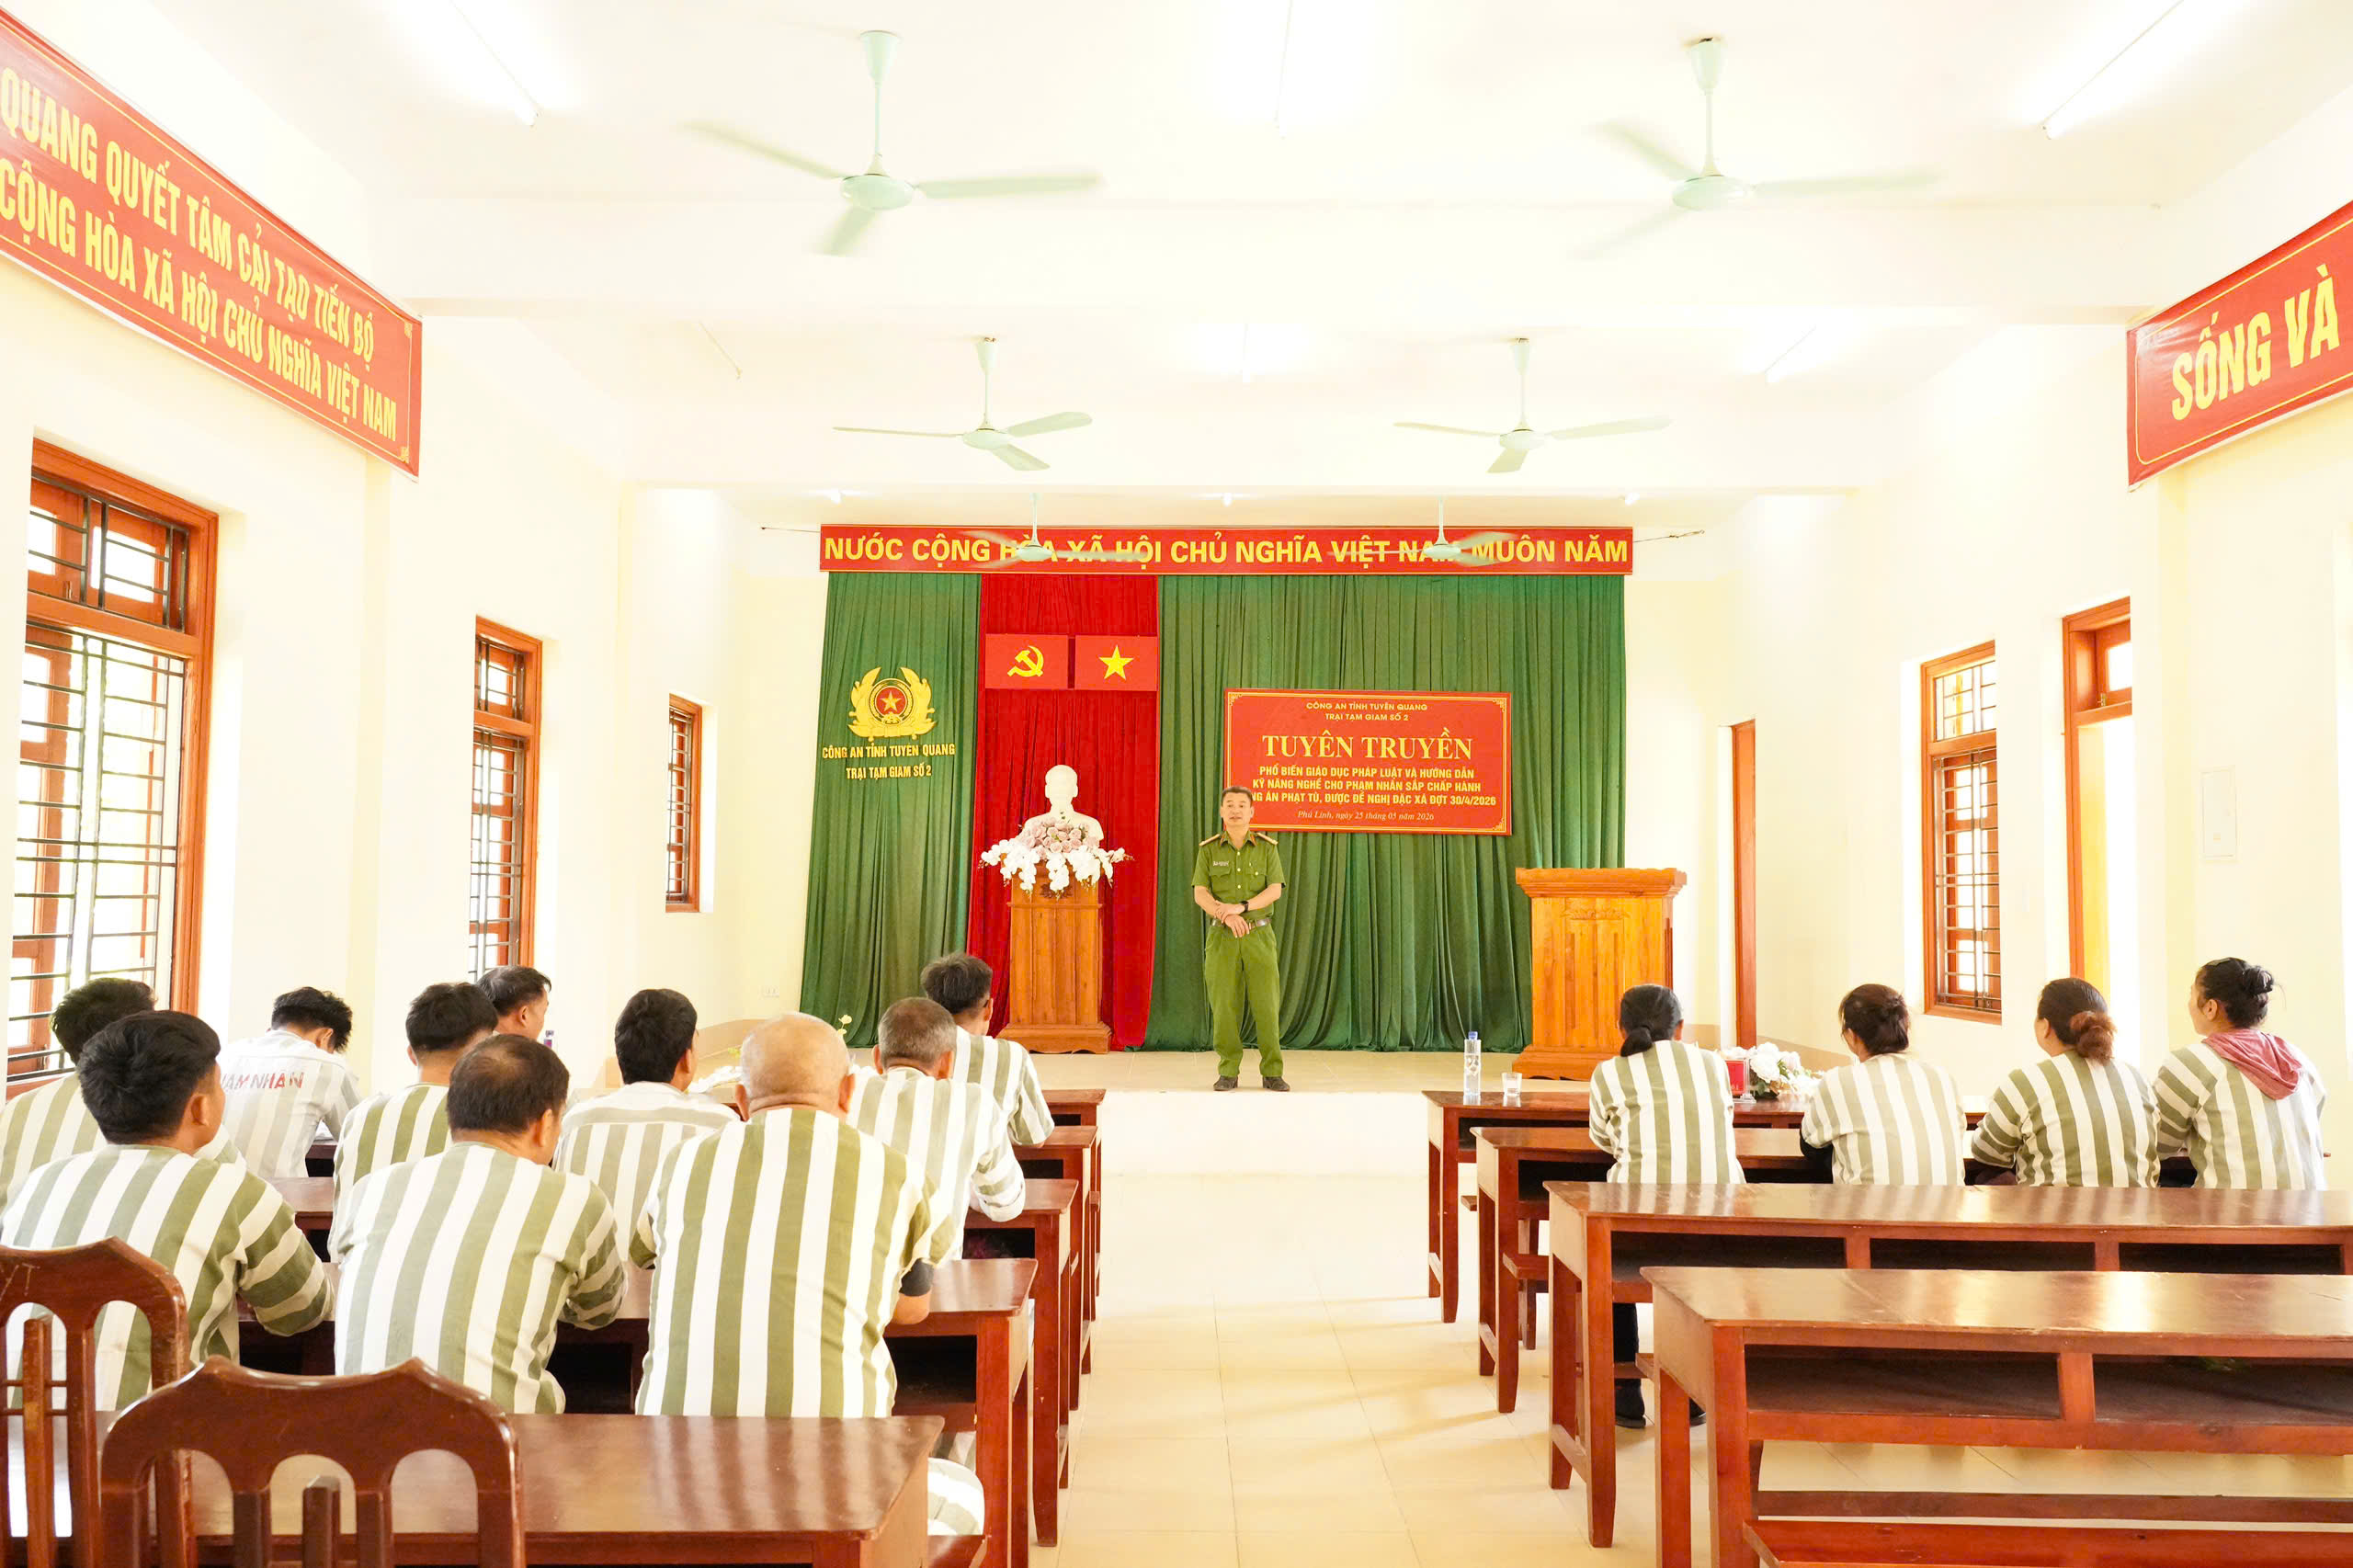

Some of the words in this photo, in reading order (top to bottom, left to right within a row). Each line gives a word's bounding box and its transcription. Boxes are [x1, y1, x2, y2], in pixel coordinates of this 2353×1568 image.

[1, 67, 97, 184] QUANG
[106, 140, 181, 236] QUYẾT
[187, 194, 232, 272] TÂM
[237, 222, 272, 296] CẢI
[274, 256, 310, 323] TẠO
[313, 283, 350, 347] TIẾN
[353, 312, 374, 372] BỘ
[0, 157, 76, 258] CỘNG
[85, 210, 137, 293] HÒA
[143, 246, 175, 314] XÃ
[181, 270, 219, 344] HỘI
[223, 295, 264, 363] CHỦ
[267, 324, 322, 399] NGHĨA
[326, 360, 360, 424] VIỆT
[362, 383, 397, 442] NAM
[2171, 310, 2272, 422] SỐNG
[2284, 263, 2340, 369] VÀ
[824, 531, 904, 561] NƯỚC
[913, 533, 991, 568] CỘNG
[1116, 534, 1162, 570] HỘI
[1171, 531, 1228, 563] CHỦ
[1235, 534, 1323, 562] NGHĨA
[1330, 534, 1391, 569] VIỆT
[1564, 533, 1628, 562] NĂM
[1306, 700, 1332, 710] CÔNG
[1348, 701, 1368, 710] TỈNH
[1370, 701, 1394, 710] TUYÊN
[1325, 712, 1343, 722] TRẠI
[1345, 713, 1362, 722] TẠM
[1389, 711, 1402, 721] SỐ
[823, 744, 847, 759] CÔNG
[849, 746, 863, 758] AN
[890, 743, 919, 757] TUYÊN
[922, 743, 956, 756] QUANG
[1262, 729, 1353, 758] TUYÊN
[1361, 727, 1472, 760] TRUYỀN
[846, 767, 867, 780] TRẠI
[869, 767, 887, 780] TẠM
[889, 765, 911, 778] GIAM
[913, 762, 925, 777] SỐ
[926, 764, 932, 776] 2
[1306, 766, 1328, 777] GIÁO
[1330, 767, 1349, 778] DỤC
[1352, 766, 1378, 778] PHÁP
[1380, 766, 1403, 779] LUẬT
[1404, 767, 1417, 778] VÀ
[1419, 767, 1452, 778] HƯỚNG
[1267, 778, 1294, 789] NĂNG
[1324, 780, 1343, 790] CHO
[1346, 781, 1373, 791] PHẠM
[1376, 779, 1403, 790] NHÂN
[1455, 780, 1482, 792] HÀNH
[1281, 792, 1305, 804] PHẠT
[1308, 791, 1323, 803] TÙ,
[1324, 792, 1350, 805] ĐƯỢC
[1367, 793, 1390, 805] NGHỊ
[1392, 792, 1412, 806] ĐẶC
[1415, 793, 1427, 804] XÁ
[1429, 794, 1448, 806] ĐỢT
[1449, 795, 1496, 806] 30/4/2026
